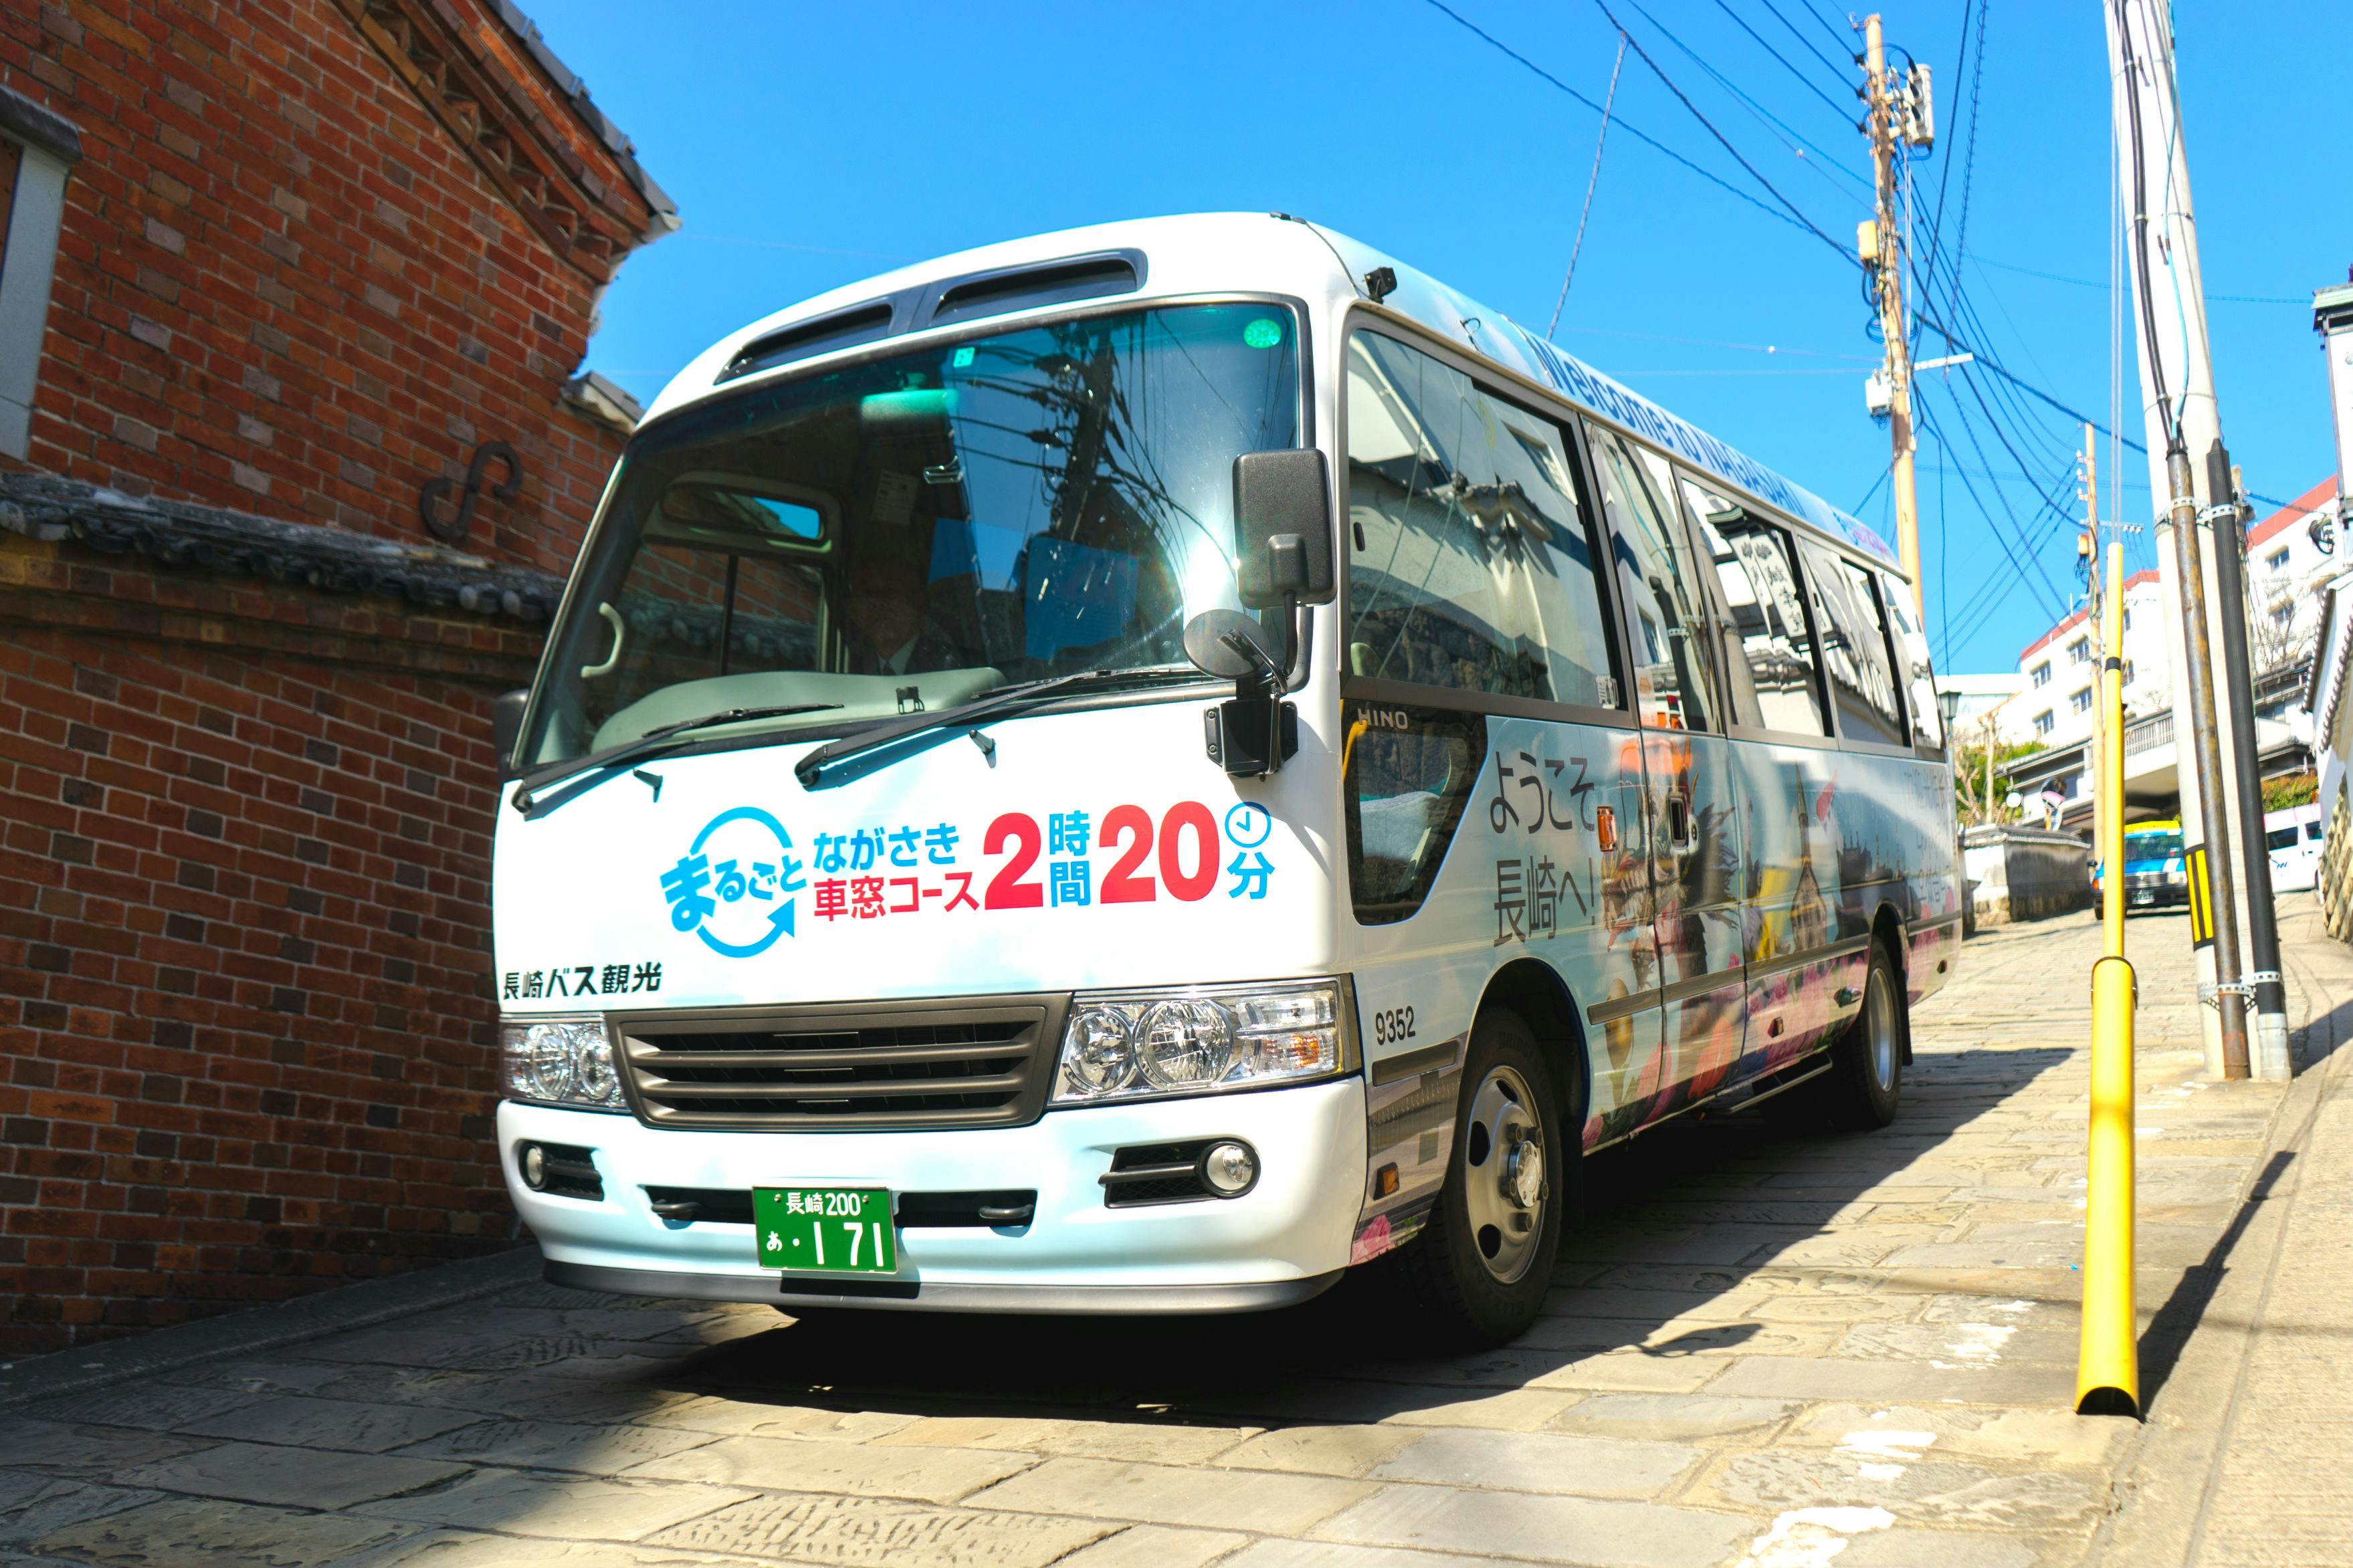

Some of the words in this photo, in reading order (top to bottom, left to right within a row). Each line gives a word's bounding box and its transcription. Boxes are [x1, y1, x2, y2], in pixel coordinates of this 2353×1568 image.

[1530, 335, 1674, 448] Welcome
[1659, 409, 1702, 463] to
[1685, 423, 1807, 519] NAGASAKI
[1357, 708, 1409, 730] HINO
[1490, 751, 1595, 834] ようこそ
[813, 822, 960, 873] ながさき
[660, 853, 807, 933] まるごと
[813, 871, 980, 922] 車窓コース
[1493, 855, 1596, 947] 長崎へ!
[503, 962, 662, 1000] 長崎バス観光
[1375, 1005, 1416, 1046] 9352
